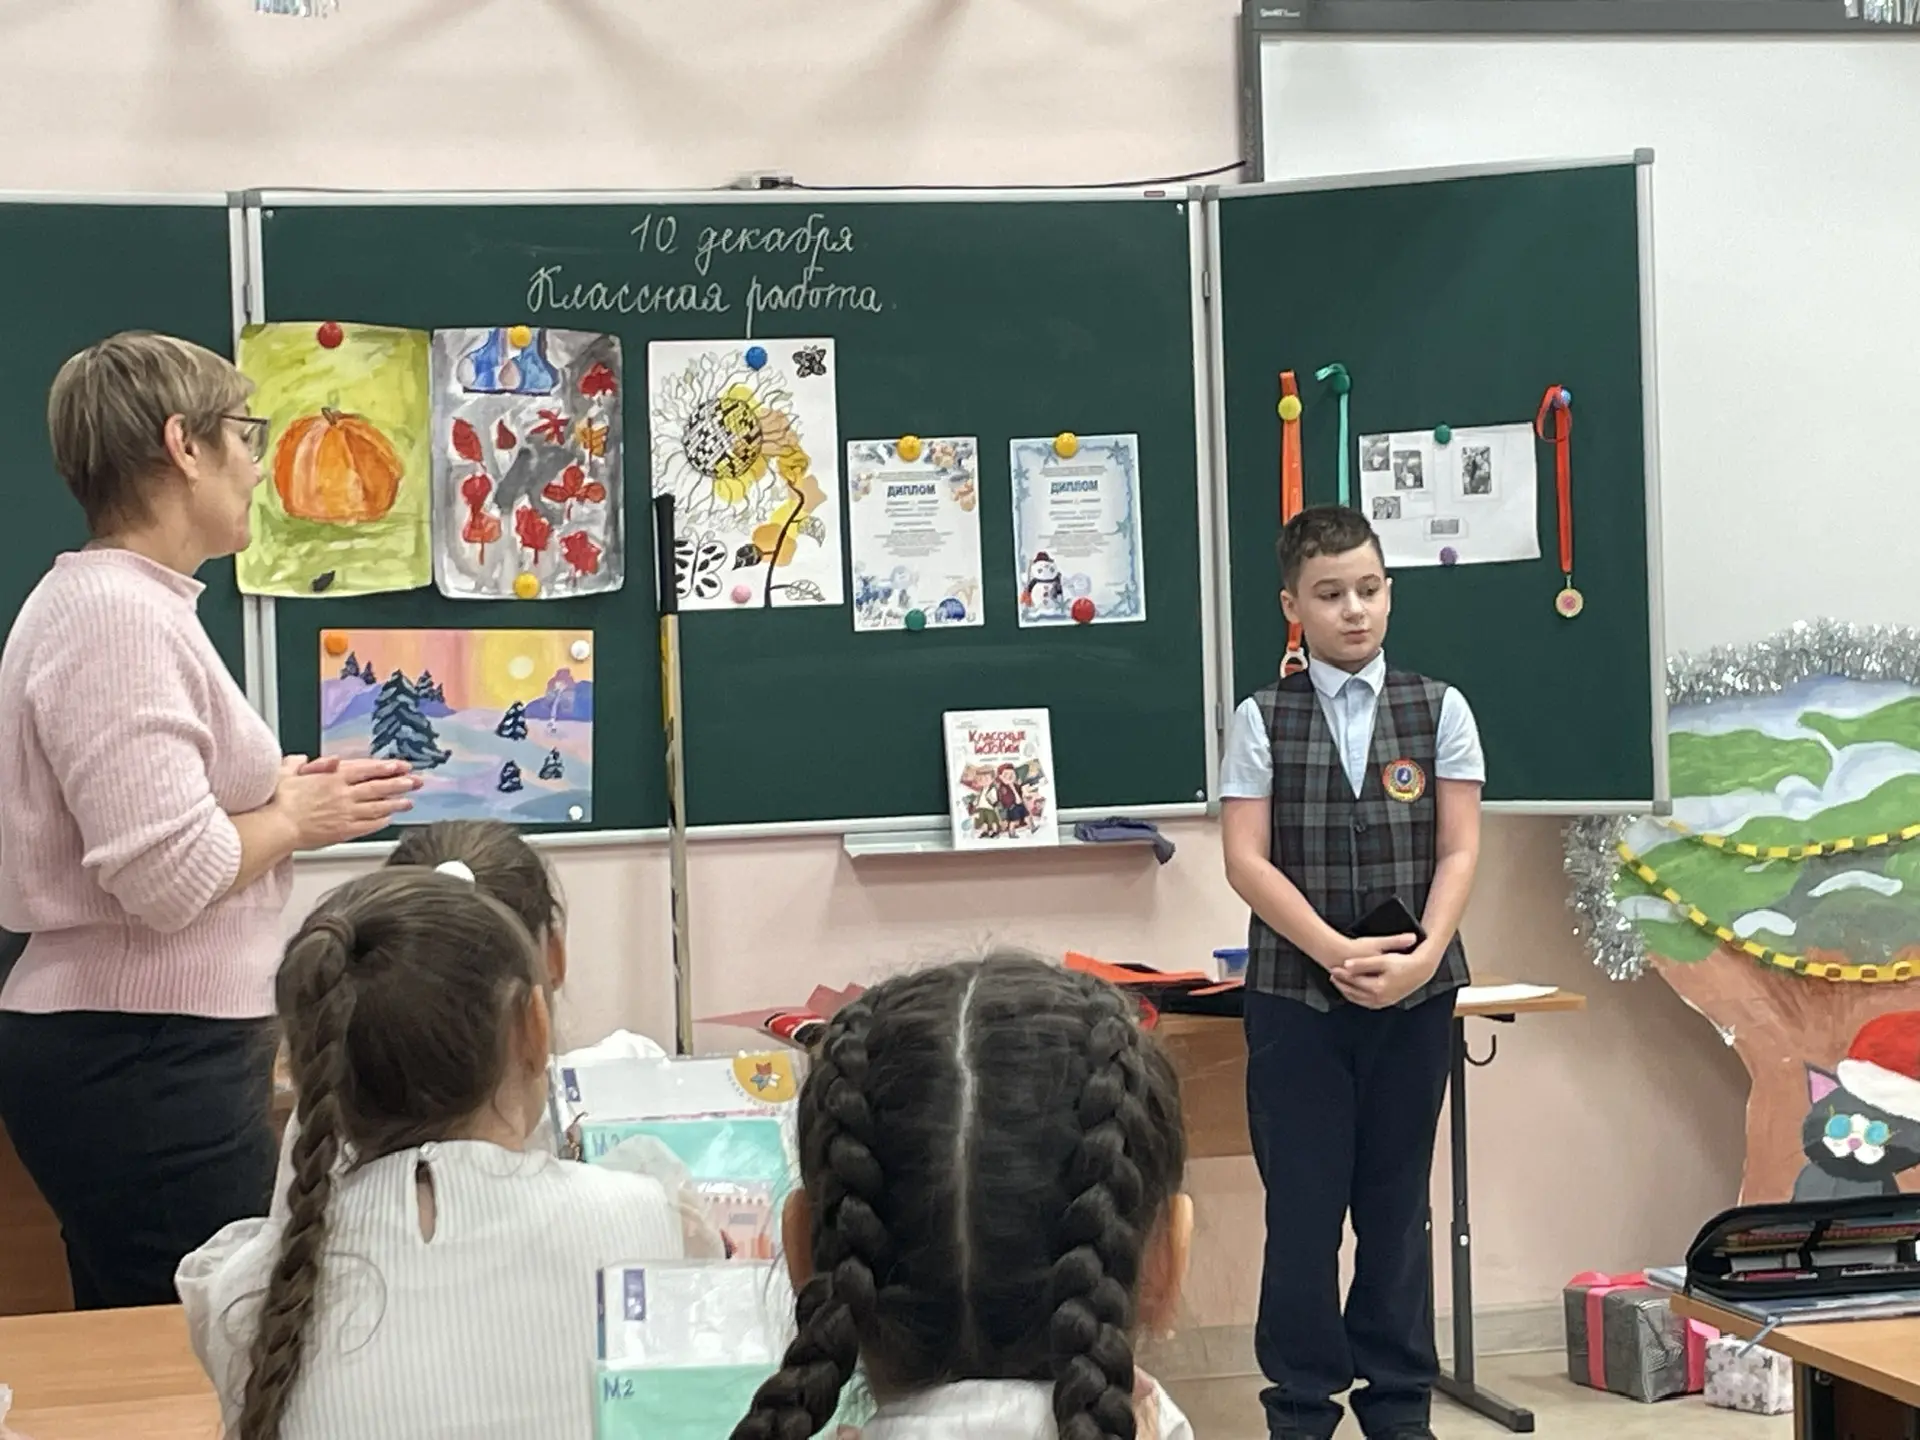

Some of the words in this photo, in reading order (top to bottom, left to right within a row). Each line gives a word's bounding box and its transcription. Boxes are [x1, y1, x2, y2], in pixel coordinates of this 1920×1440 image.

[630, 213, 677, 252] 10
[694, 213, 855, 281] декабря
[526, 265, 731, 313] Классная
[746, 266, 883, 338] работа
[886, 483, 936, 498] ДИПЛОМ
[1050, 479, 1099, 495] ДИПЛОМ
